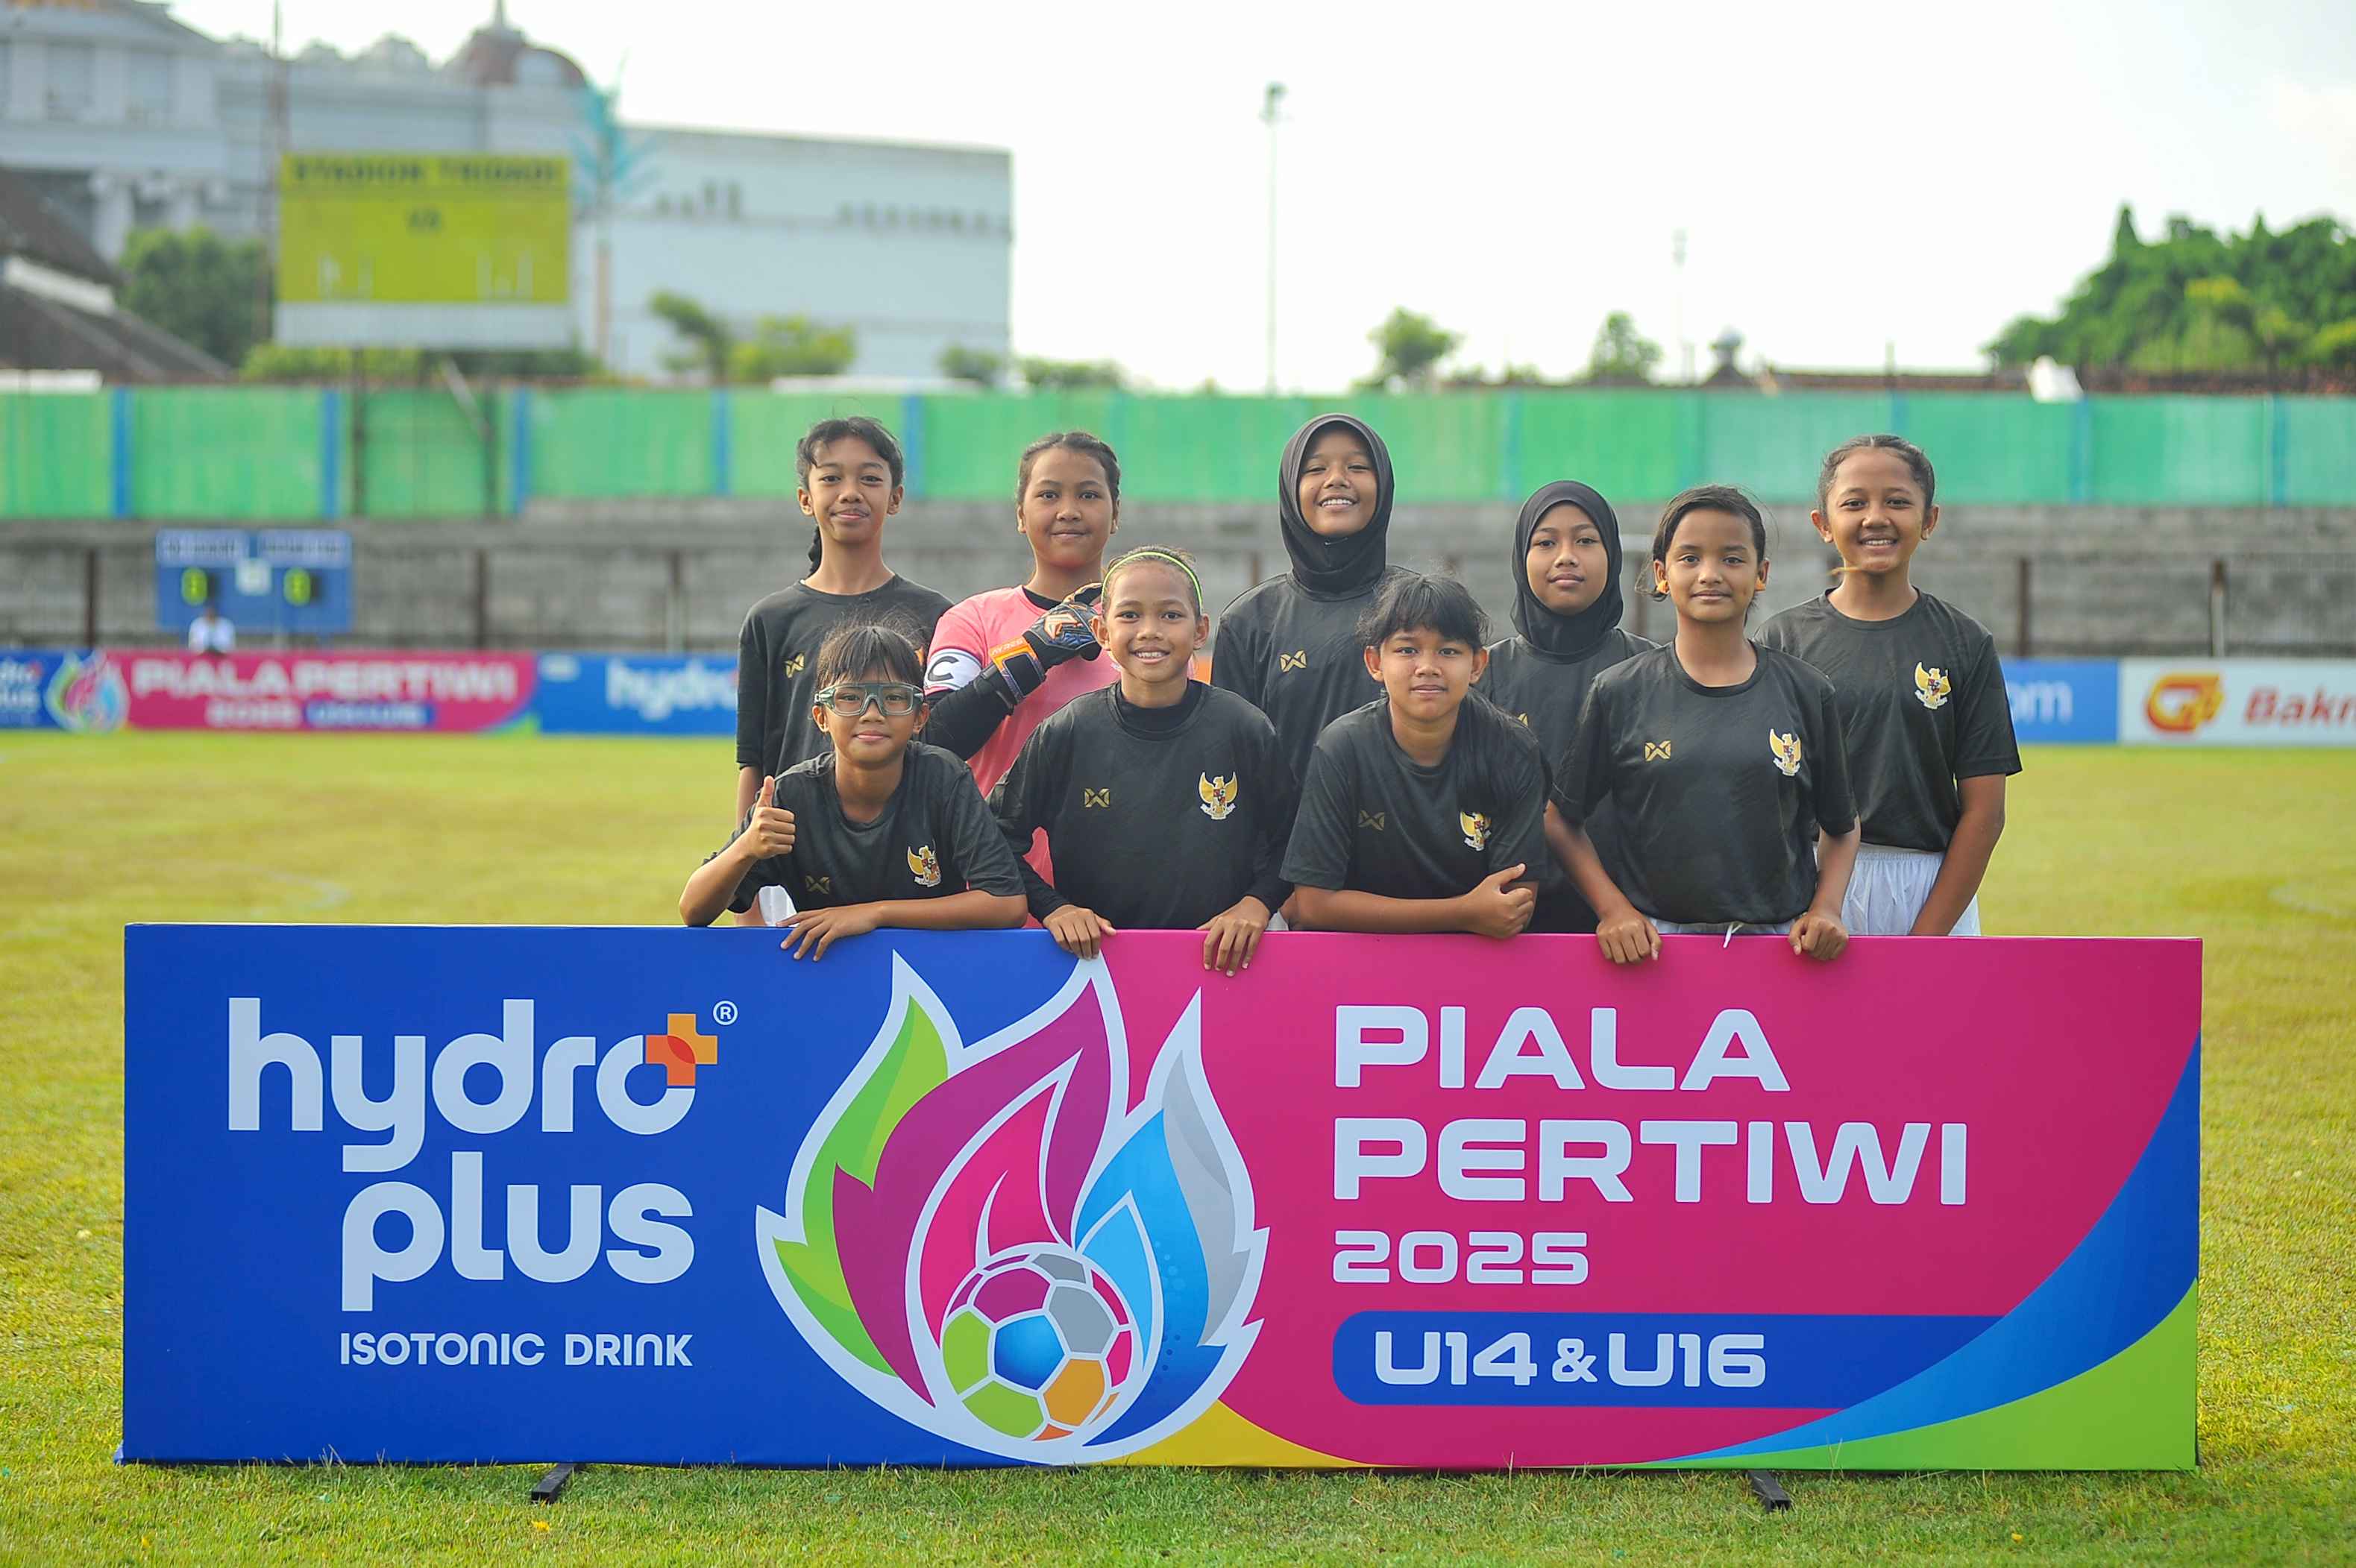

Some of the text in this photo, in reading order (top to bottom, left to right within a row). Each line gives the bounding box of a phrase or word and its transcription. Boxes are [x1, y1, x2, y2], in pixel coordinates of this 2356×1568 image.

[133, 661, 291, 697] PIALA
[293, 662, 518, 701] PERTIWI
[928, 656, 959, 681] C
[1336, 1005, 1791, 1091] PIALA
[229, 998, 697, 1172] hydro
[1334, 1118, 1967, 1205] PERTIWI
[342, 1151, 695, 1312] plus
[1333, 1230, 1589, 1284] 2025
[341, 1332, 693, 1366] ISOTONIC DRINK
[1375, 1331, 1766, 1388] U14 & U16
